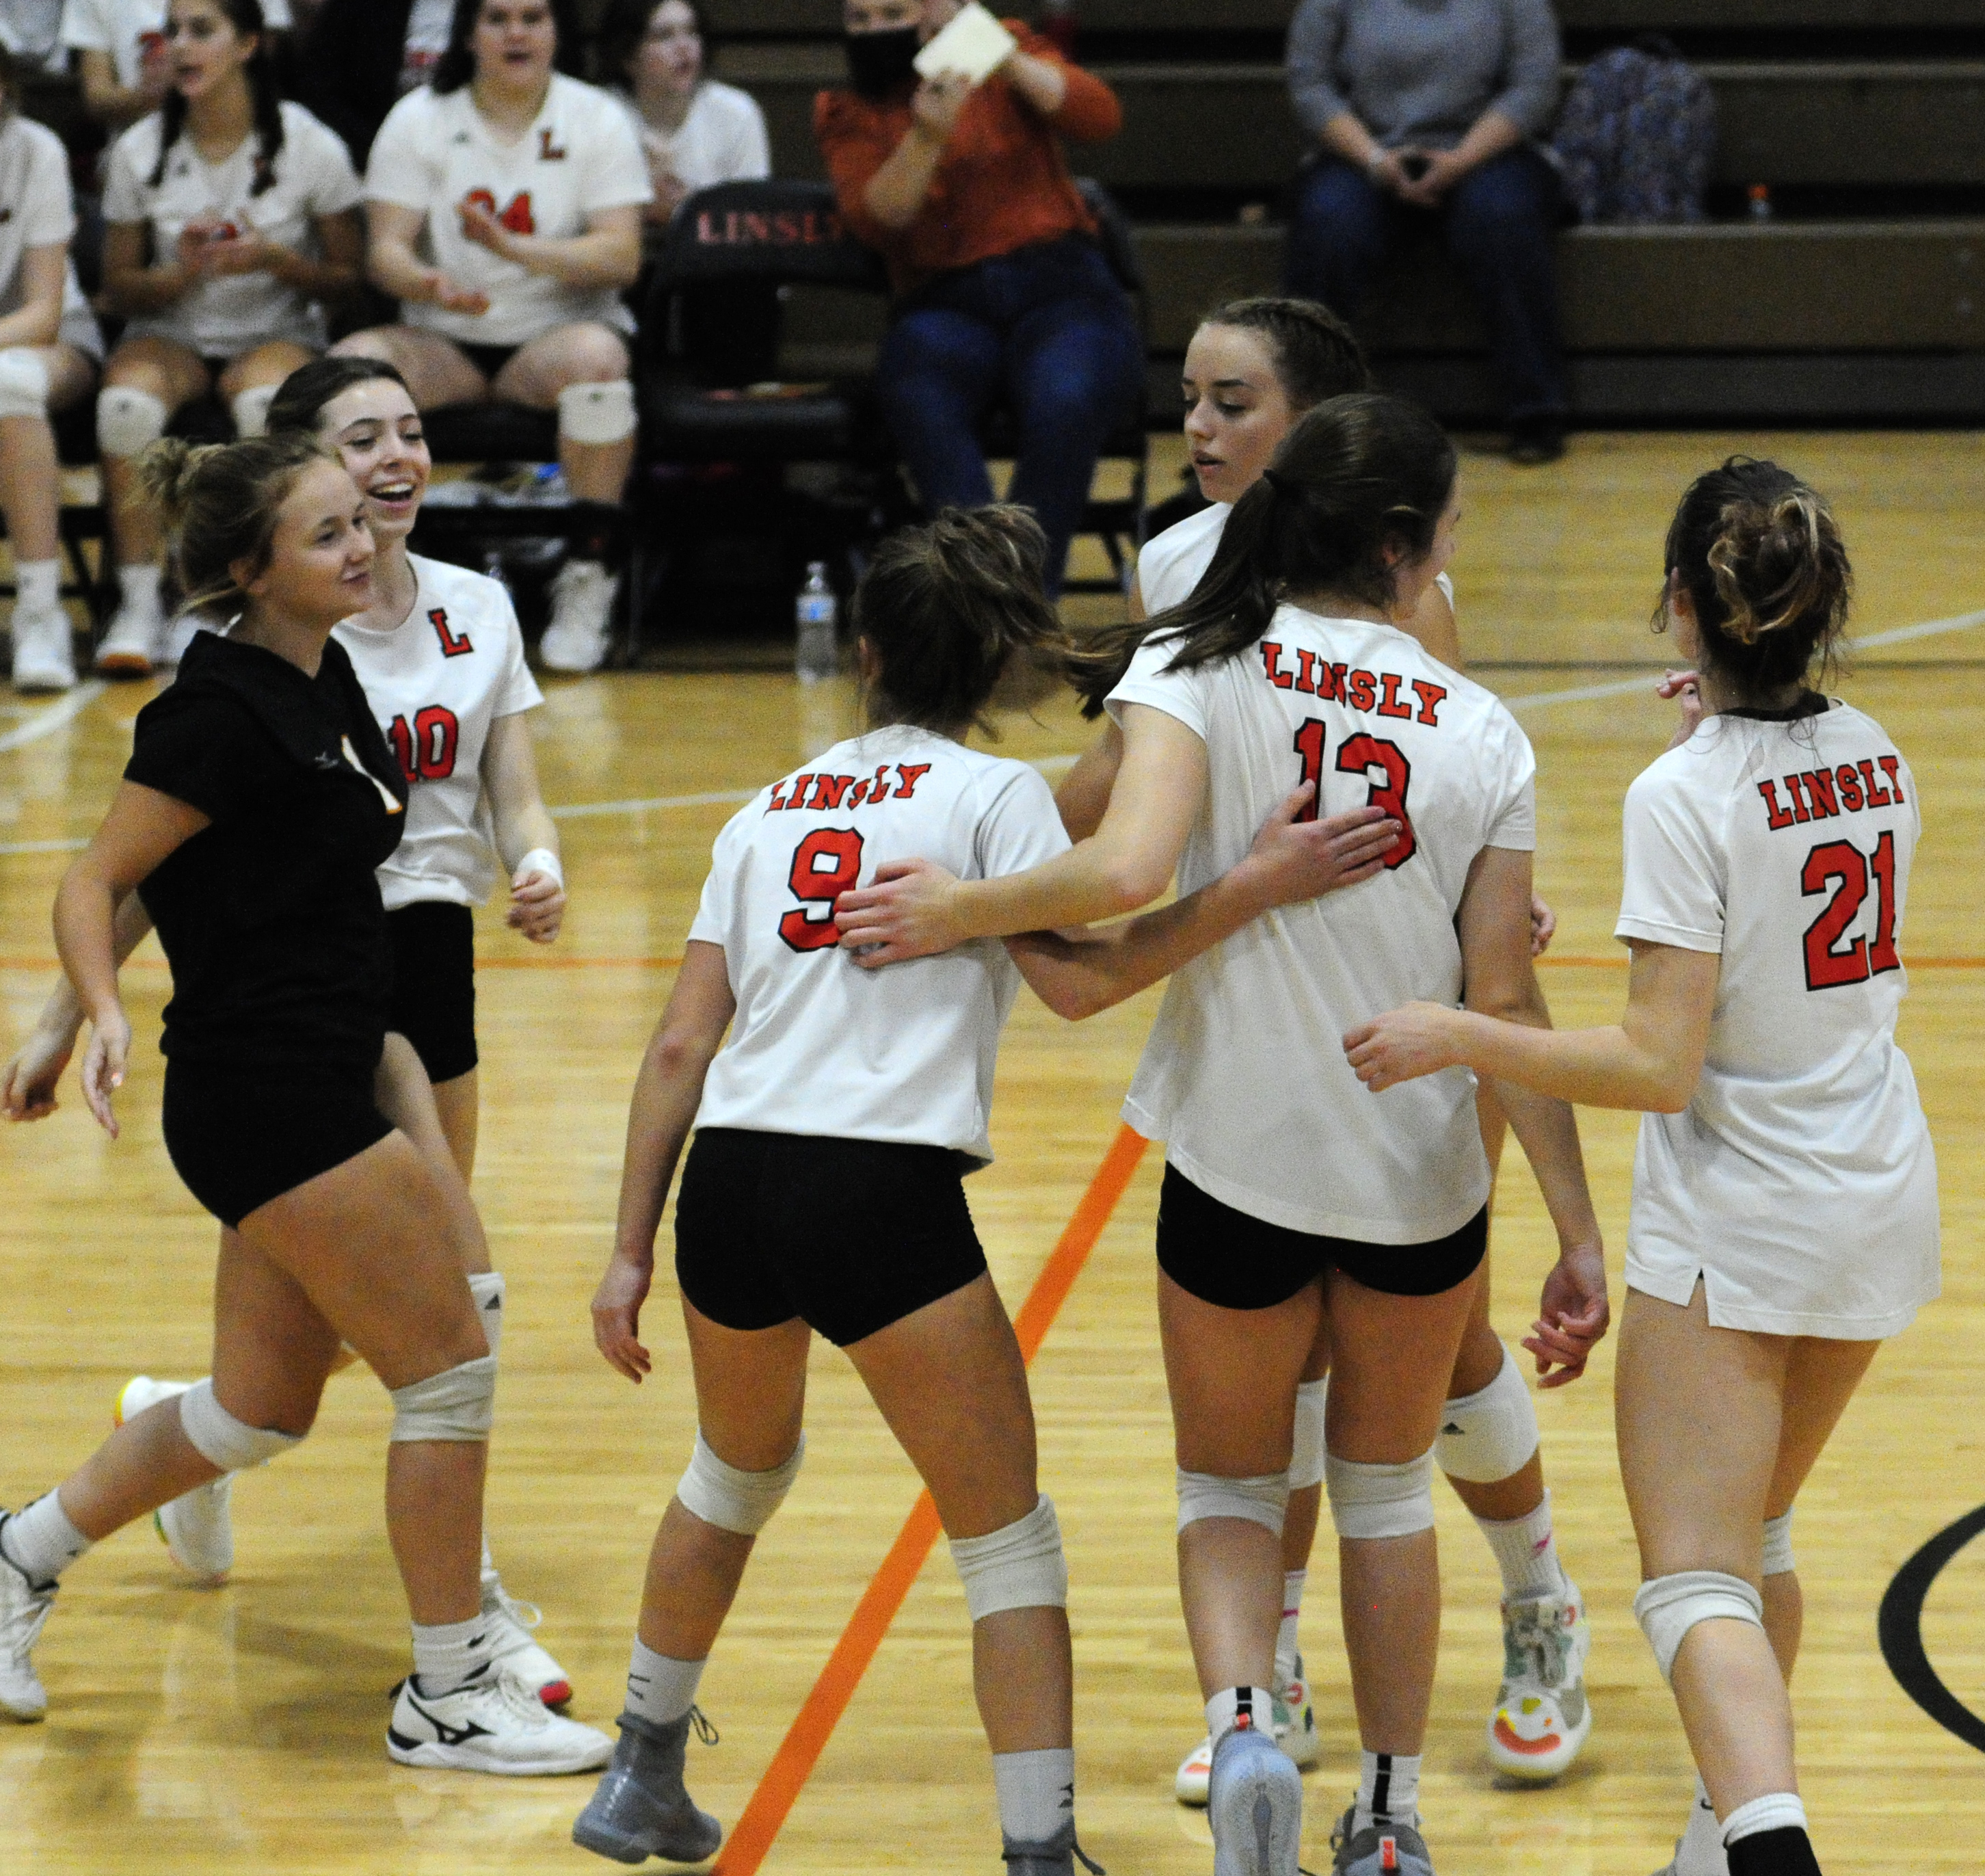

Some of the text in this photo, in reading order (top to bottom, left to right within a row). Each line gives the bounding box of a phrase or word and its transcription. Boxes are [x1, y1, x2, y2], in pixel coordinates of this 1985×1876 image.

[538, 127, 567, 160] L
[427, 607, 474, 657] L
[1260, 640, 1448, 727] LINSLY
[388, 704, 459, 783] 10
[762, 763, 932, 819] LINSLY
[1292, 716, 1417, 869] 13
[1757, 755, 1905, 831] LINSLY
[777, 827, 865, 953] 9
[1800, 830, 1900, 992] 21
